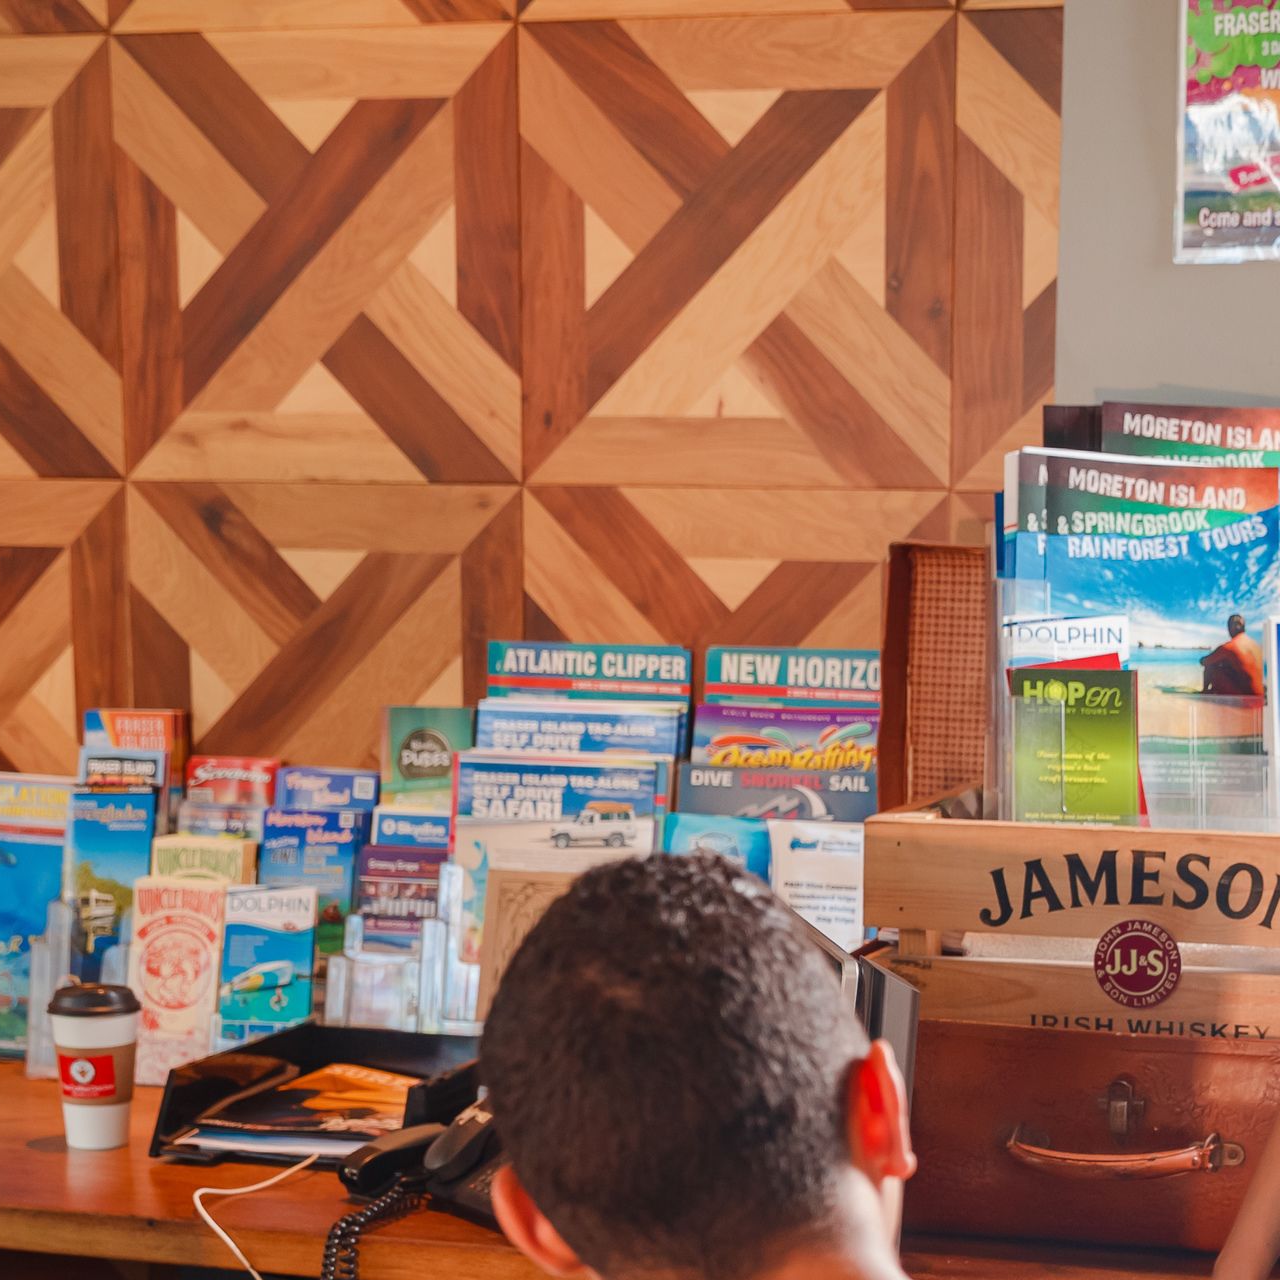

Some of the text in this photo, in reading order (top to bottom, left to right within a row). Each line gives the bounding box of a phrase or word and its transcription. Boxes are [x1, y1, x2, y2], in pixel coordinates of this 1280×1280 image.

[1198, 207, 1239, 228] Come
[1242, 207, 1271, 227] and
[1123, 411, 1222, 446] MORETON
[1068, 465, 1247, 511] MORETON ISLAND
[1057, 509, 1212, 536] & SPRINGBROOK
[1067, 515, 1269, 562] RAINFOREST TOURS
[1017, 625, 1124, 645] DOLPHIN
[503, 647, 686, 680] ATLANTIC CLIPPER
[721, 651, 881, 691] NEW HORIZO
[472, 784, 511, 801] SELF
[690, 769, 870, 793] DIVE SNORKEL SAIL
[472, 797, 563, 821] SAFARI
[229, 895, 311, 914] DOLPHIN
[1096, 921, 1179, 960] JOHN JAMESON
[1105, 948, 1164, 977] JJ&S
[1103, 981, 1129, 1004] SON
[1133, 972, 1178, 1006] LIMITED
